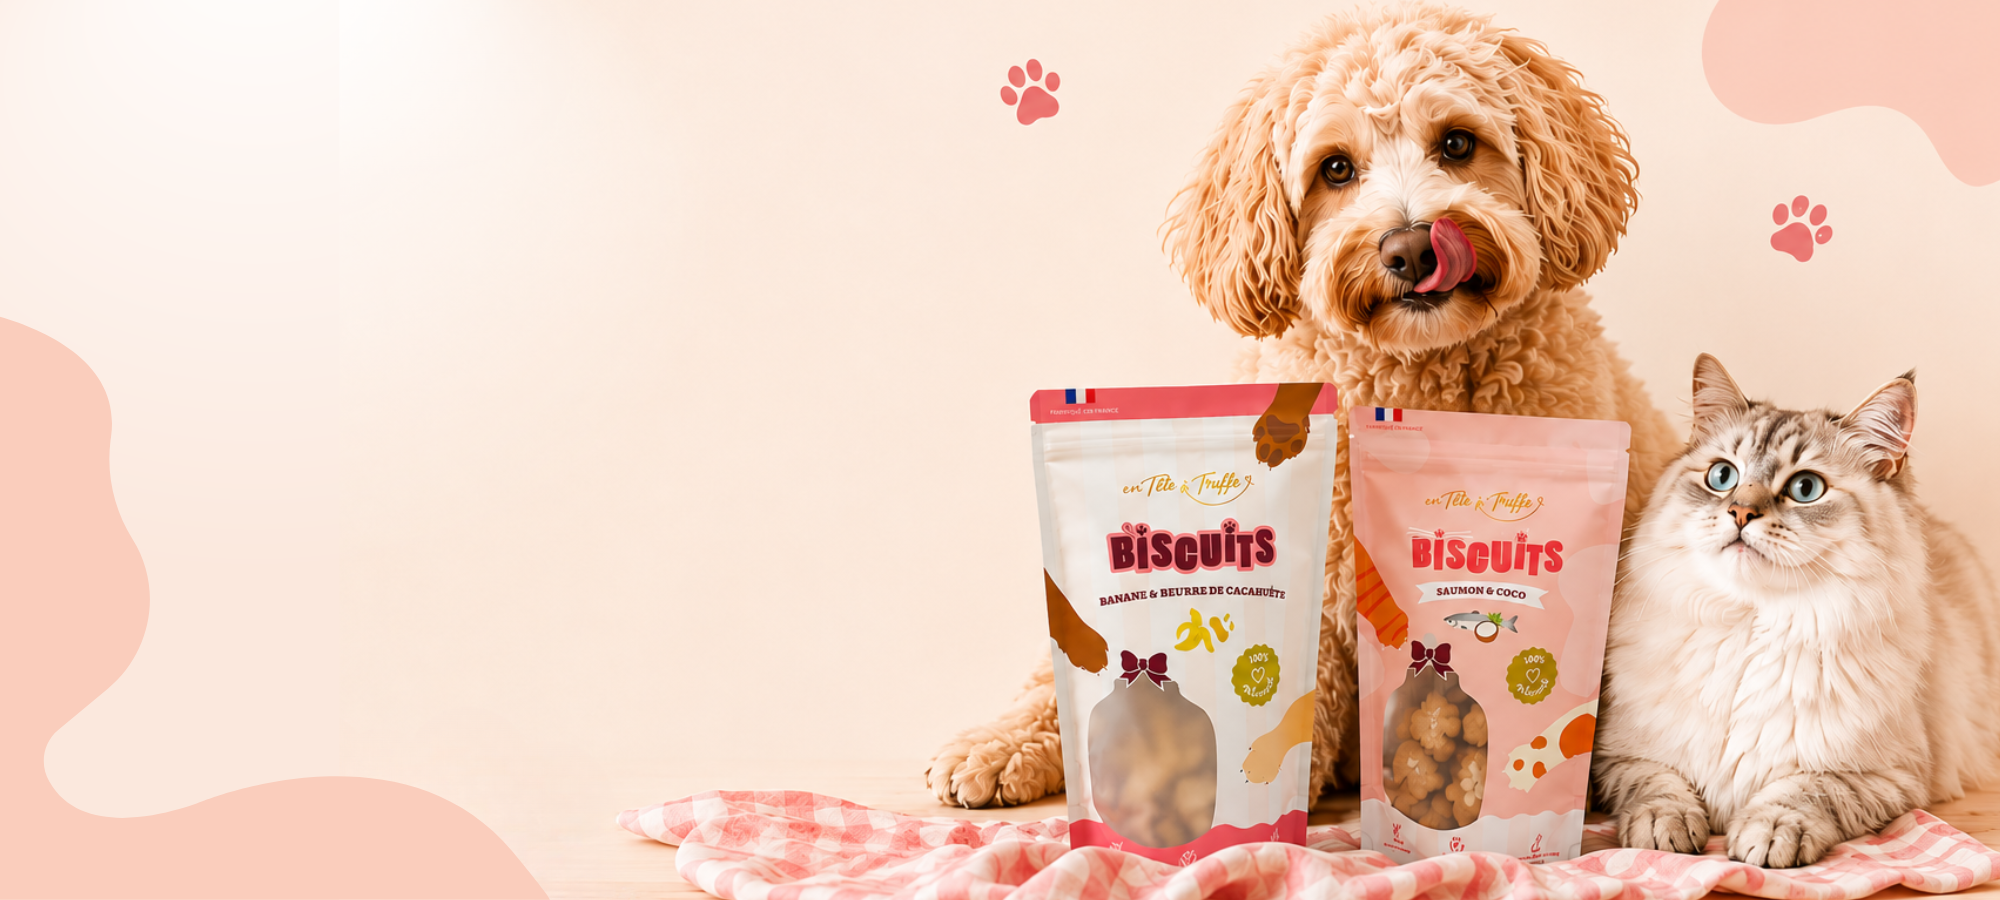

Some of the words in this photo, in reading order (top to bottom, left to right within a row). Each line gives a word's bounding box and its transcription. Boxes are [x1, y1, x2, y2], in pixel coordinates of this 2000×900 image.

[1123, 484, 1142, 494] en
[1191, 471, 1241, 496] Truffe
[1425, 498, 1442, 506] en
[1486, 491, 1534, 514] Truffe
[1100, 590, 1148, 607] BANANE
[1149, 590, 1158, 599] &
[1160, 586, 1207, 598] BEURRE
[1209, 586, 1224, 595] DE
[1436, 586, 1485, 596] SAUMON
[1486, 586, 1494, 595] &
[1496, 587, 1527, 600] COCO
